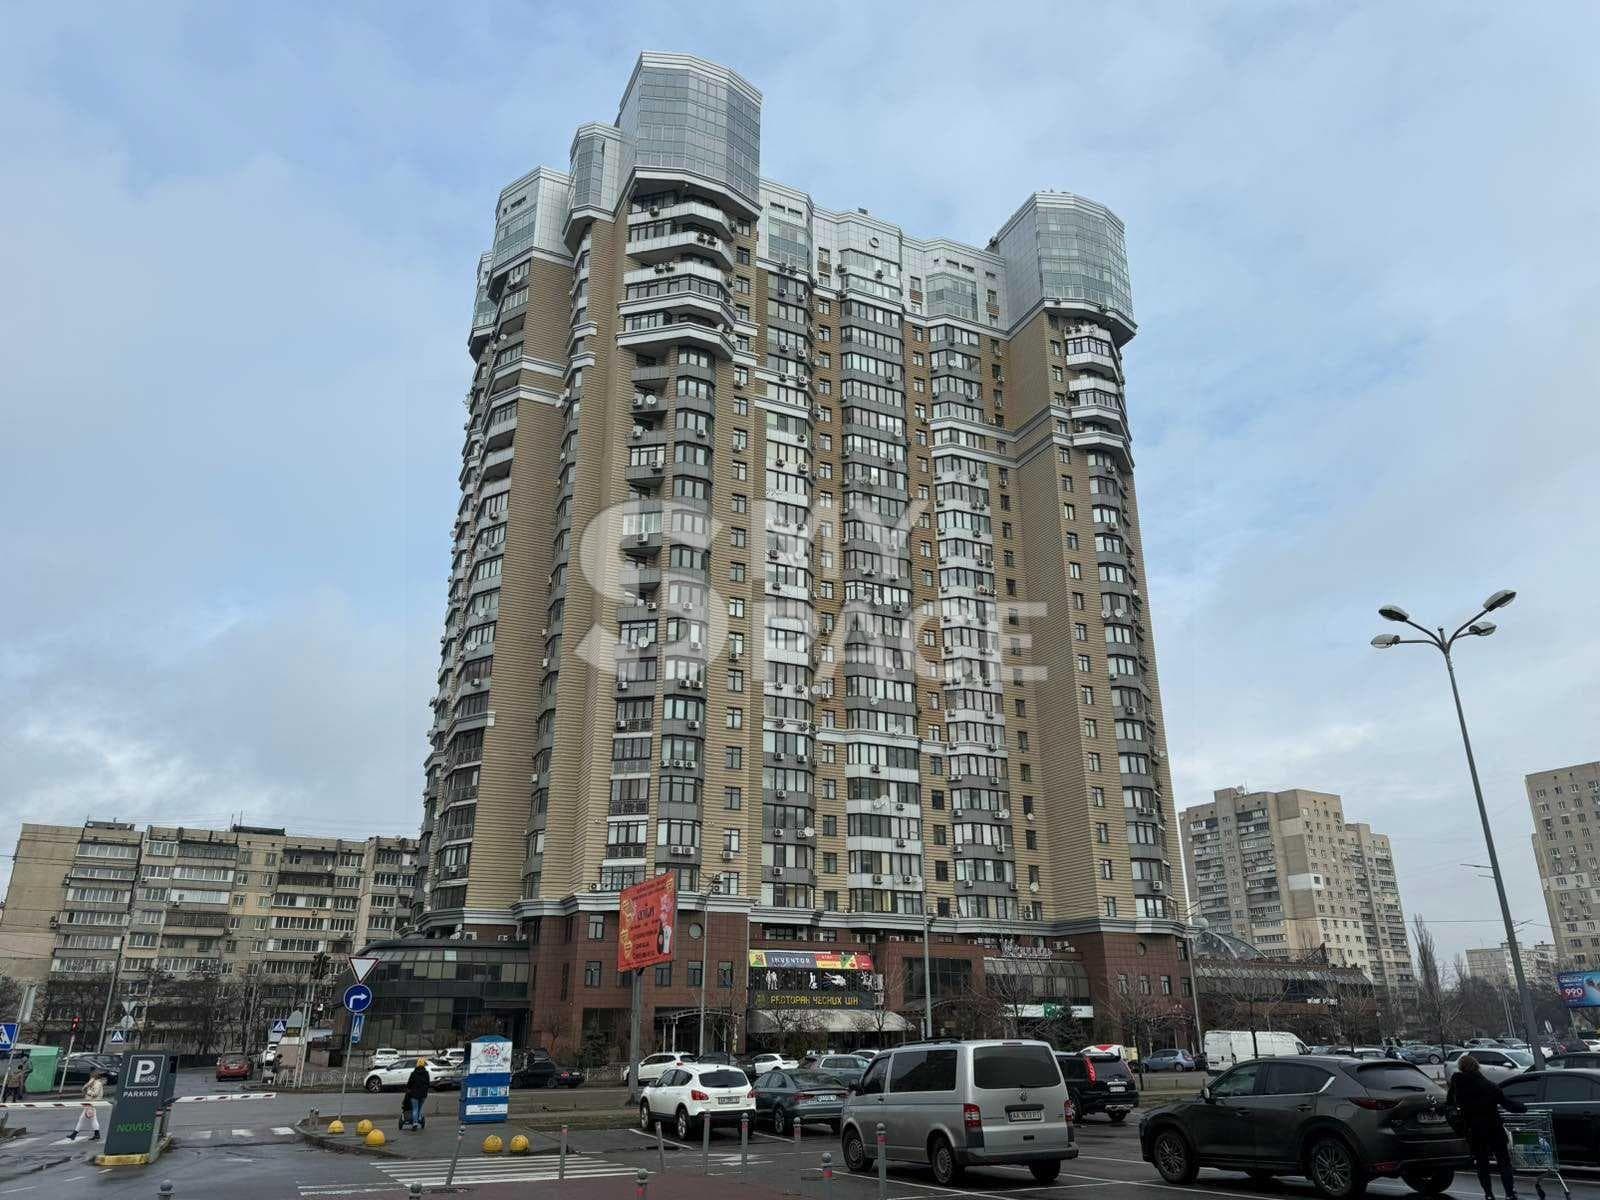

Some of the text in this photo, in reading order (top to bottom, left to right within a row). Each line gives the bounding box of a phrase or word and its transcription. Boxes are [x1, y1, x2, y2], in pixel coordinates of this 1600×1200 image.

[771, 956, 811, 964] INVENTOR
[770, 995, 812, 1005] РЕСТОРАН
[135, 1060, 155, 1083] P
[117, 1122, 153, 1133] NOVUS
